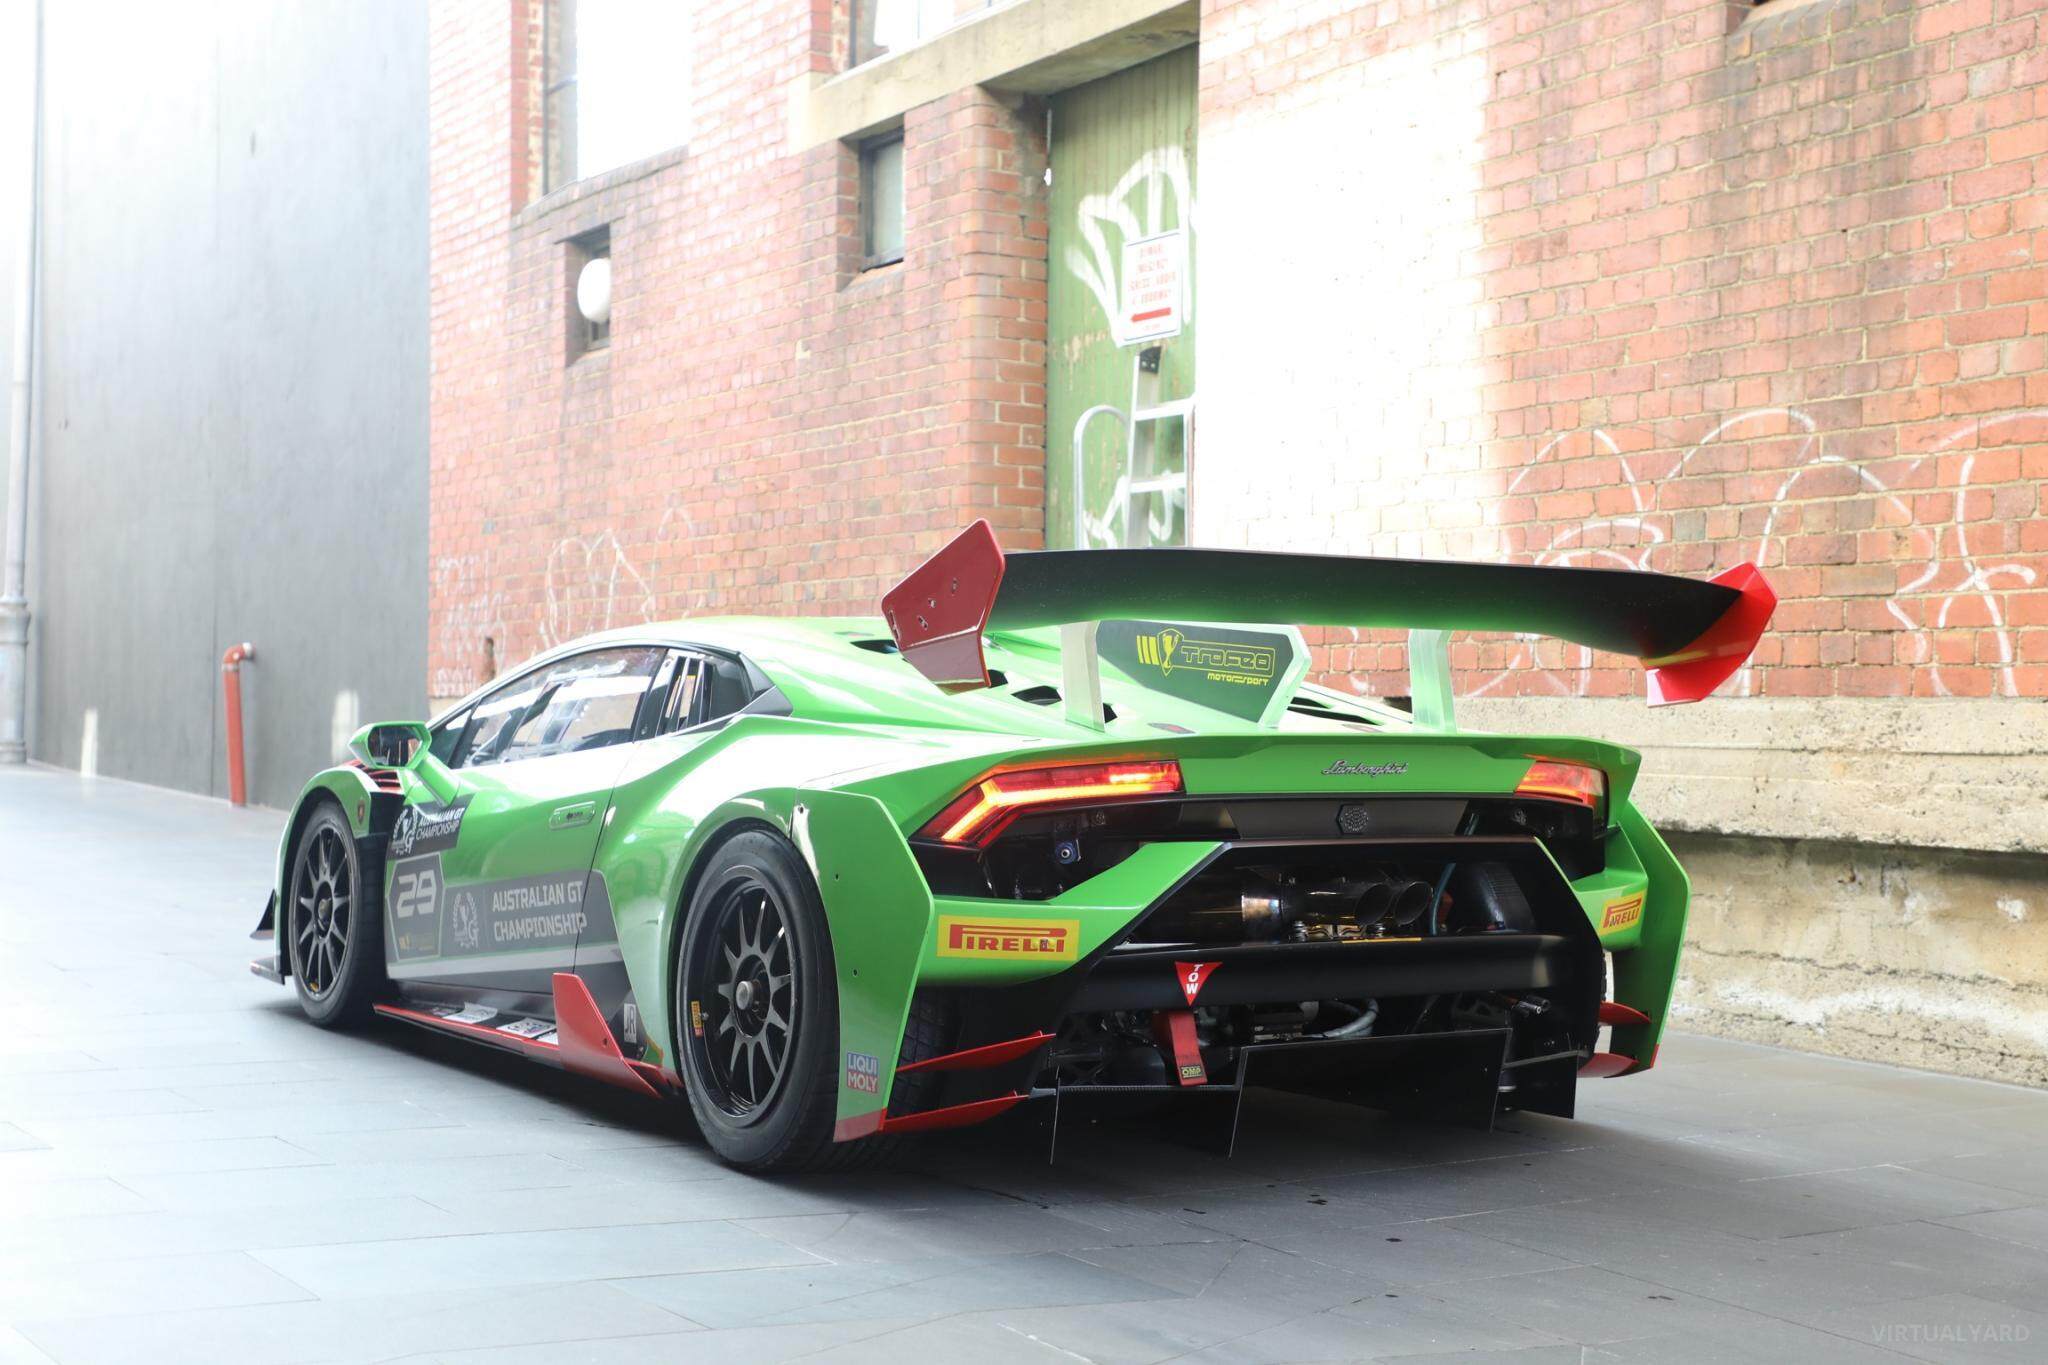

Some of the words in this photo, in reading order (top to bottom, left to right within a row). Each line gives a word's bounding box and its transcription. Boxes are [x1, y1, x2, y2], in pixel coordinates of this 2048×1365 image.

[1321, 759, 1409, 777] Lamborghini
[396, 869, 437, 919] 29
[492, 881, 565, 913] AUSTRALIAN
[567, 880, 584, 904] GT
[493, 911, 588, 942] CHAMPIONSHIP
[1603, 898, 1642, 929] PIRELLI
[948, 923, 1068, 953] PIRELLI
[1186, 963, 1204, 995] TOW
[625, 1004, 637, 1034] JR
[847, 1053, 878, 1076] LIQUI
[847, 1071, 878, 1093] MOLY
